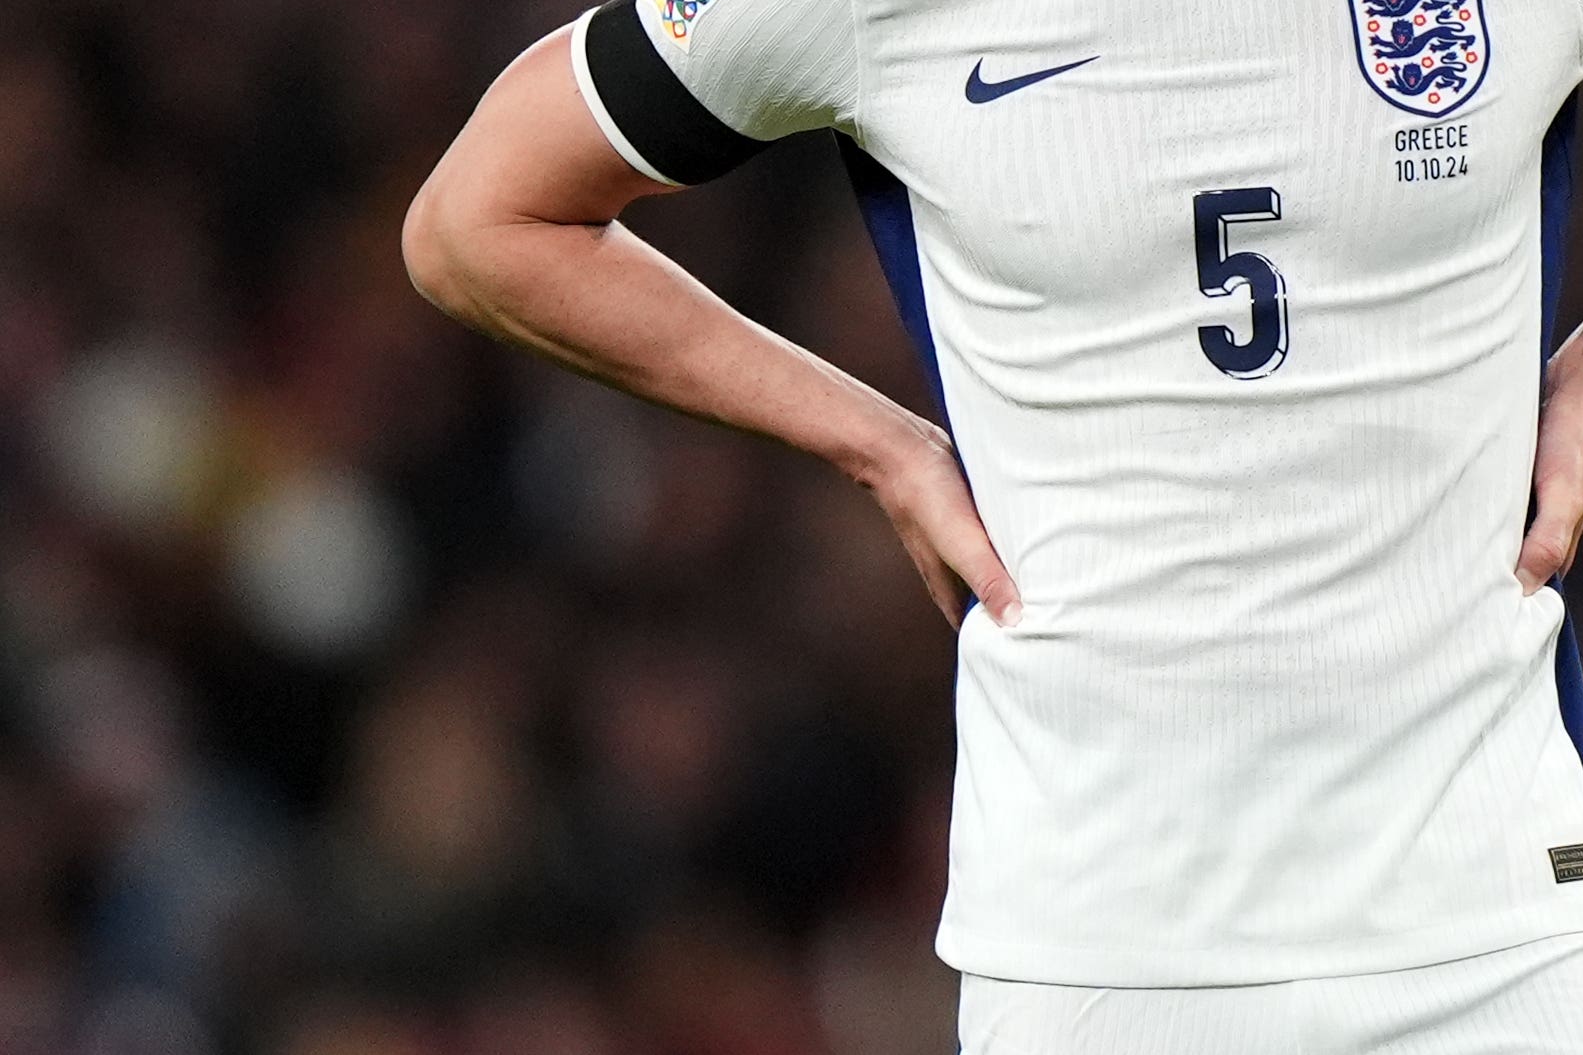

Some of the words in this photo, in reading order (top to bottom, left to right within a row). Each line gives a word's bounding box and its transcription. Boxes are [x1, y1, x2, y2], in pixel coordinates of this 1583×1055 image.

[1395, 125, 1468, 152] GREECE
[1395, 155, 1468, 182] 10.10.24
[1193, 187, 1289, 380] 5
